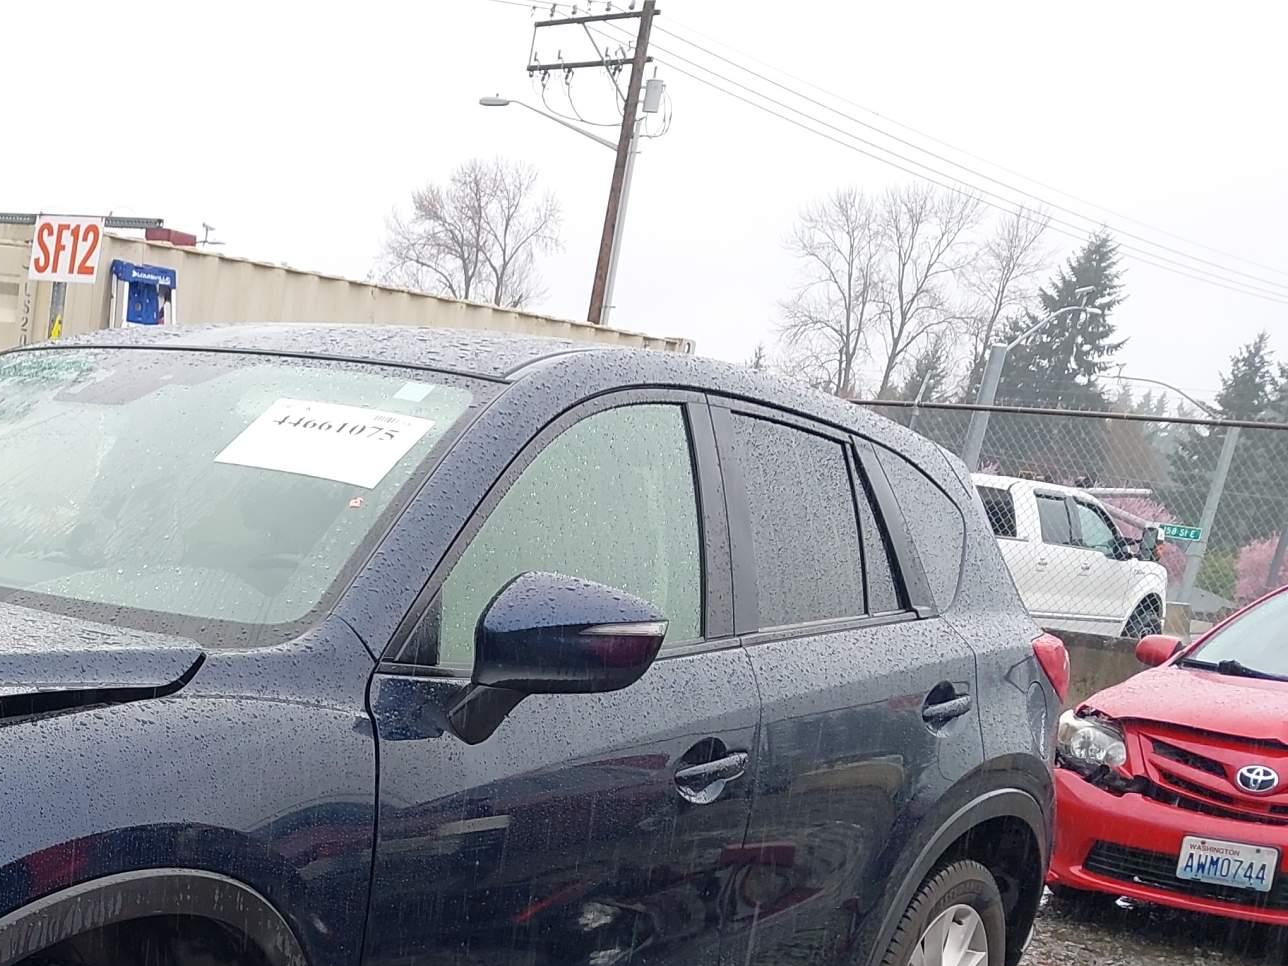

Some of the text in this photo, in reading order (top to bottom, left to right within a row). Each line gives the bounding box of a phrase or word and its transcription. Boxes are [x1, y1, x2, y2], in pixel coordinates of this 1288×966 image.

[34, 222, 100, 275] SF12
[273, 415, 400, 441] 44661075
[1189, 843, 1241, 857] WASHINGTON
[1183, 852, 1267, 885] AWM0744
